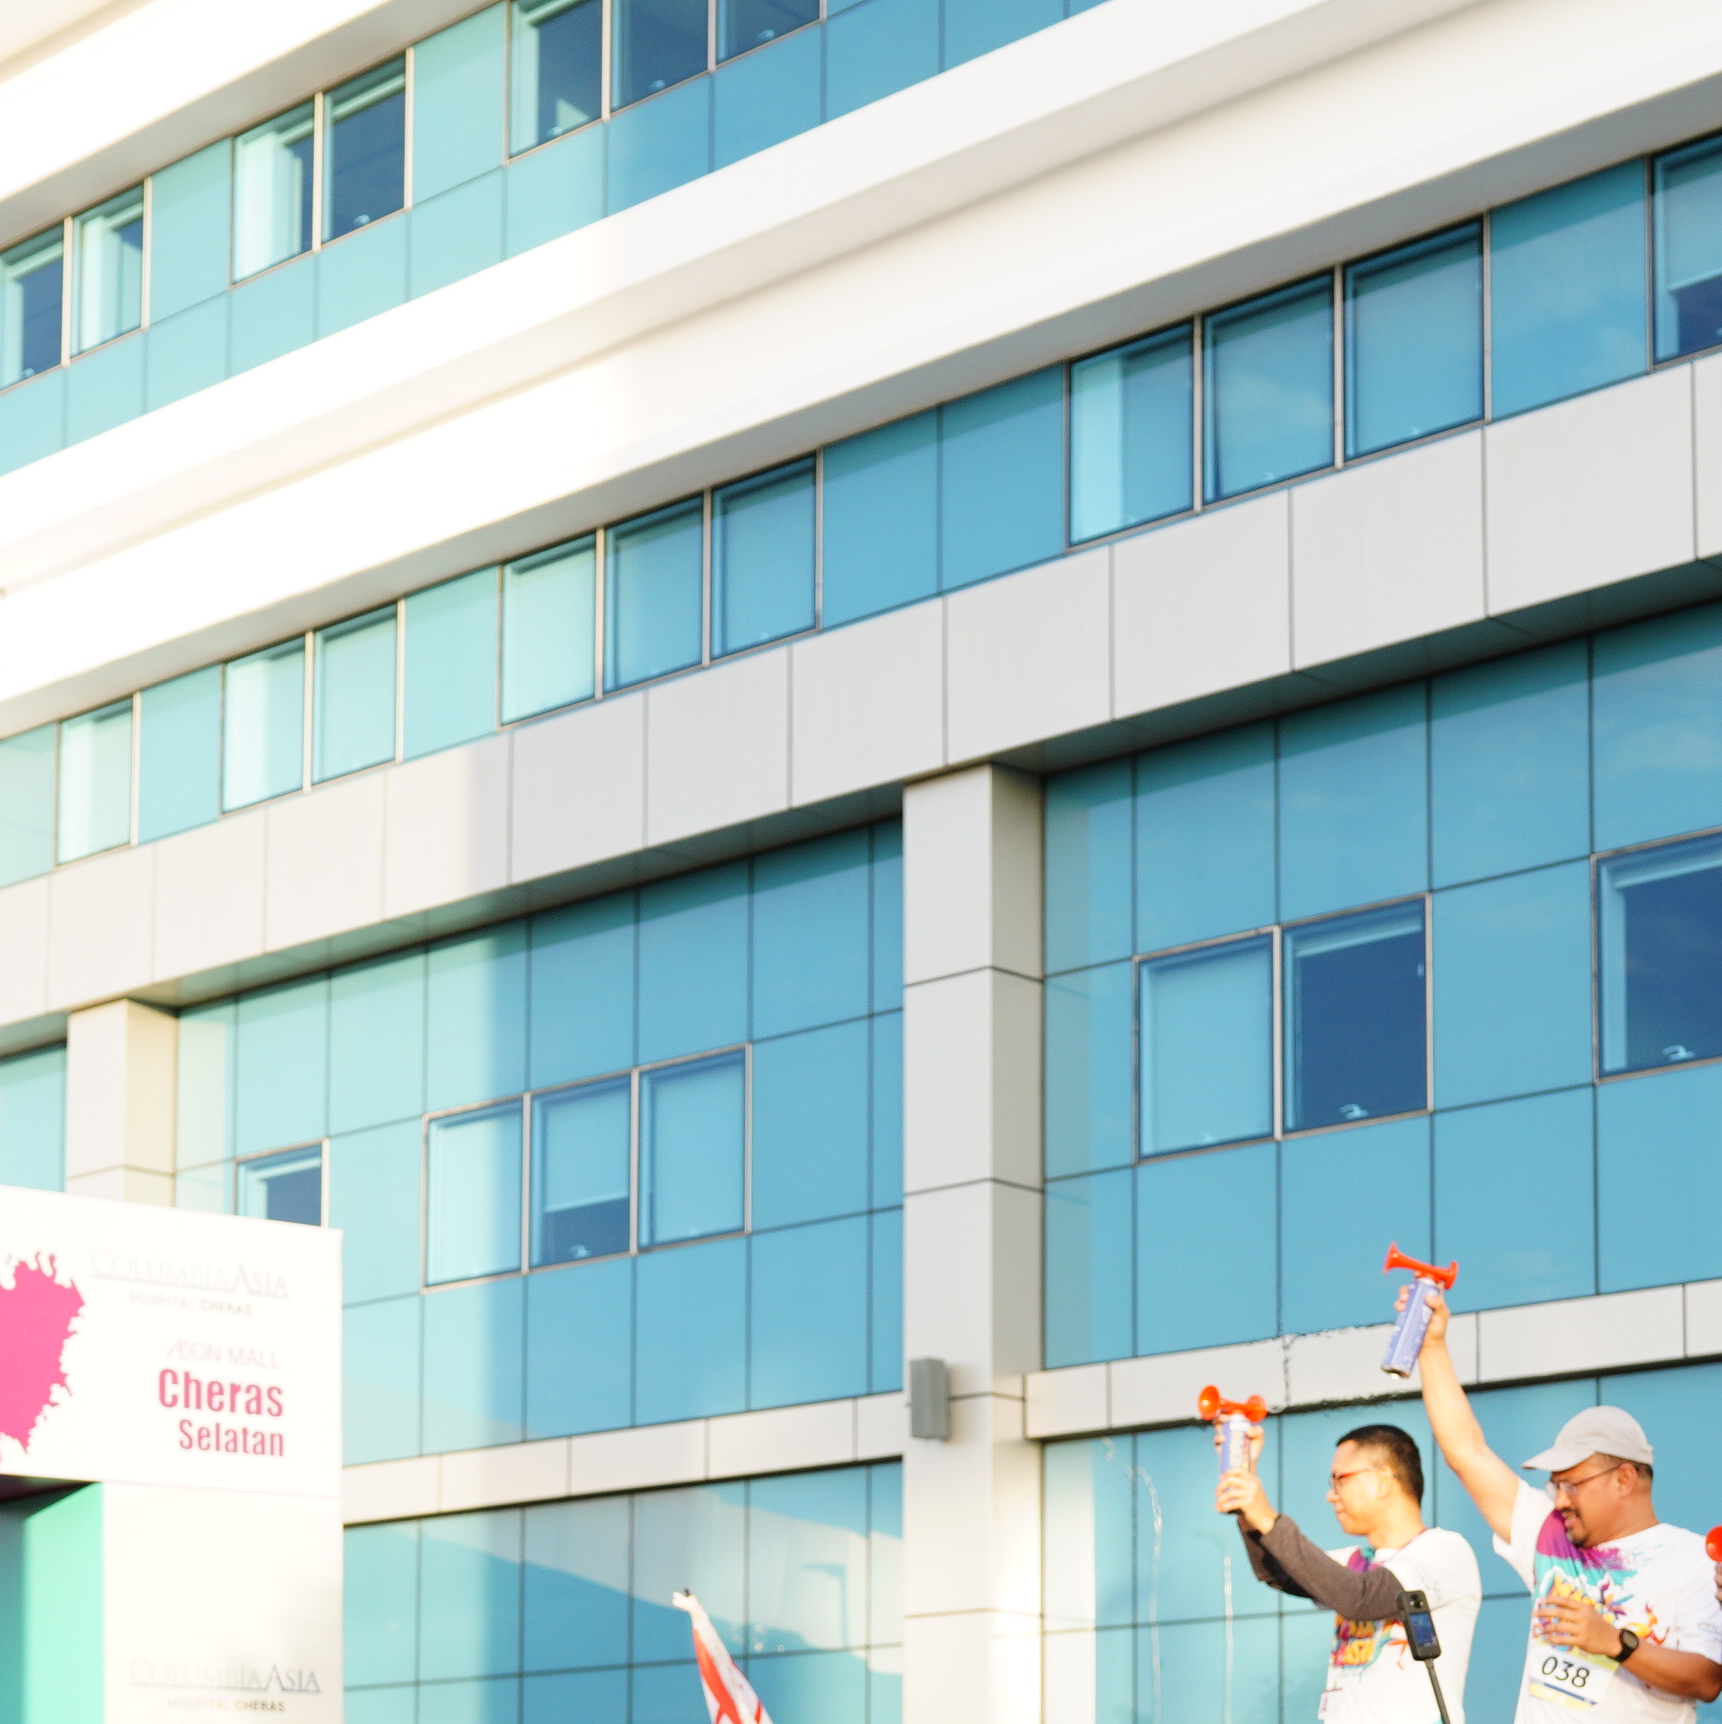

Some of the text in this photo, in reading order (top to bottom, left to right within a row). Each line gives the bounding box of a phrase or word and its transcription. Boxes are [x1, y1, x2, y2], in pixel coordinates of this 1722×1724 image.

[227, 1344, 282, 1371] MALL
[158, 1368, 284, 1418] Cheras
[178, 1418, 285, 1458] Selatan
[1540, 1655, 1591, 1689] 038
[234, 1698, 286, 1713] CHERAS
